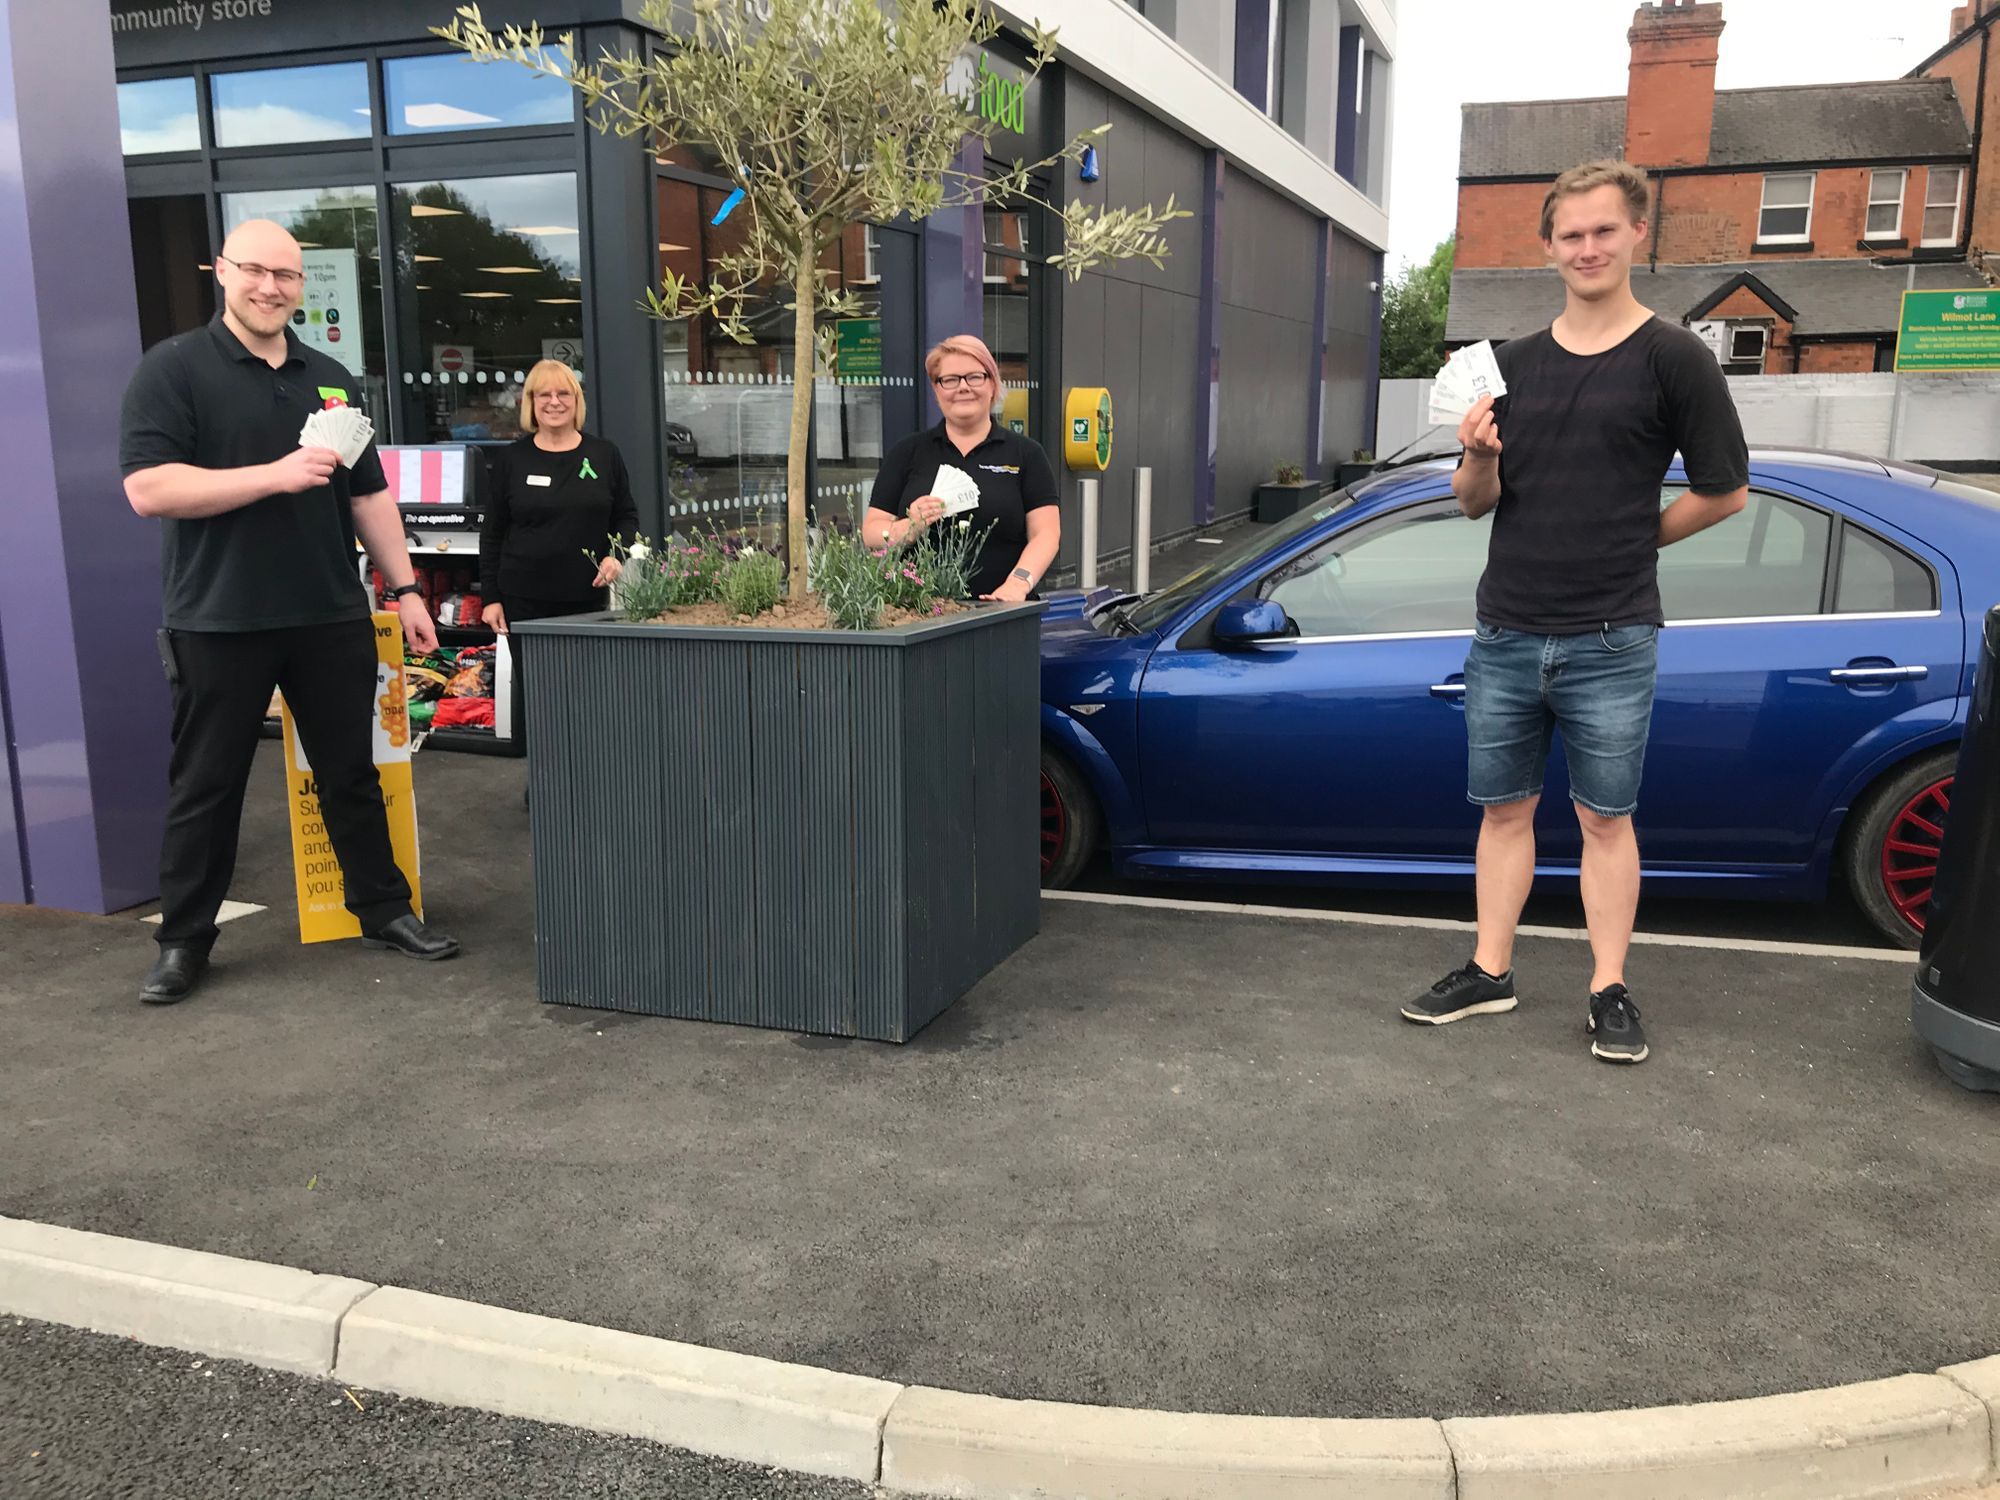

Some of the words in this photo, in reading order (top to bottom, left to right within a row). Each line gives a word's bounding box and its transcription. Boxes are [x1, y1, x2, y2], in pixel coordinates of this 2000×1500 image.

[212, 0, 272, 20] store
[979, 51, 1025, 134] food
[1942, 312, 1972, 322] Wilmot
[1974, 311, 1996, 321] Lane
[957, 490, 976, 504] £10
[304, 840, 332, 855] and
[307, 880, 334, 898] you
